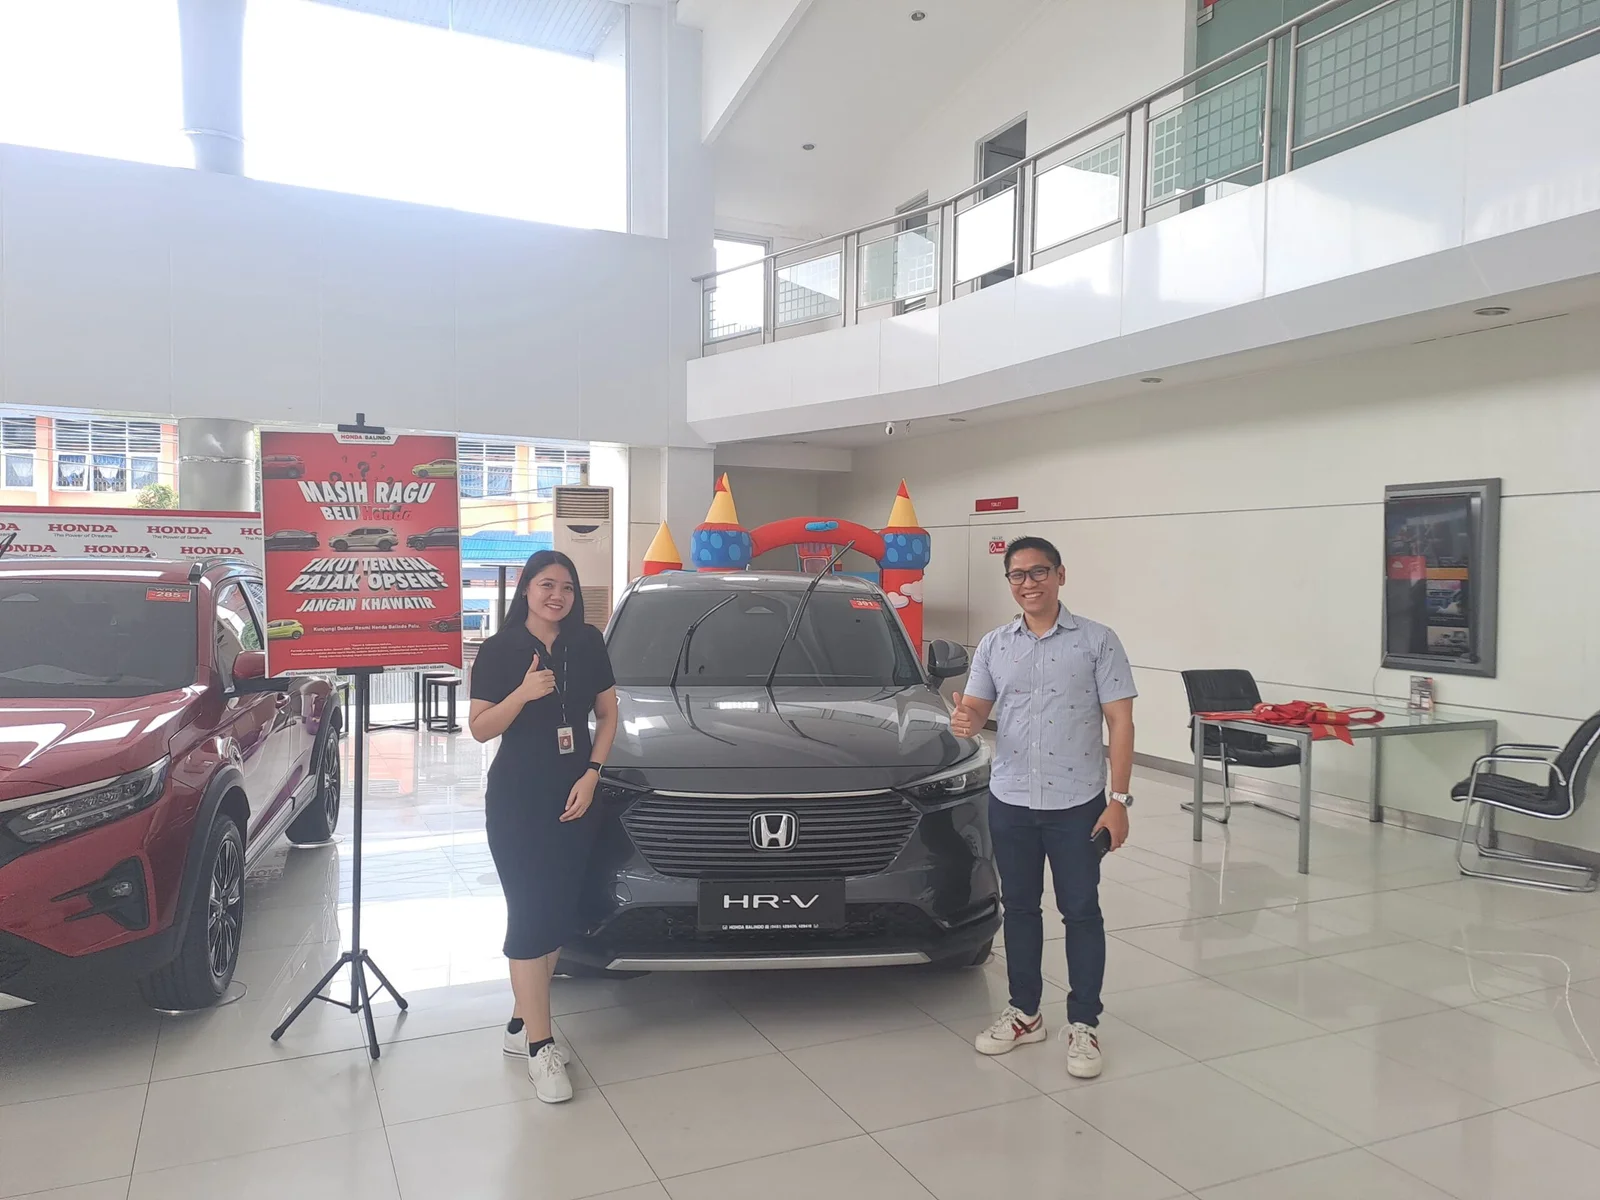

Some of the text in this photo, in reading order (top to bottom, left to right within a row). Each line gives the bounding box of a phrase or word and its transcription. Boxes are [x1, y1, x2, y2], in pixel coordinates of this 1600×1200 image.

[297, 481, 436, 504] MASIH RAGU
[319, 506, 359, 521] BELI
[47, 523, 119, 533] HONDA
[146, 525, 213, 535] HONDA
[83, 544, 151, 554] HONDA
[180, 546, 245, 555] HONDA
[299, 556, 440, 573] TAKUT TERKENA
[285, 573, 361, 592] PAJAK
[295, 596, 437, 613] JANGAN KHAWATIR
[723, 894, 820, 909] HR-V
